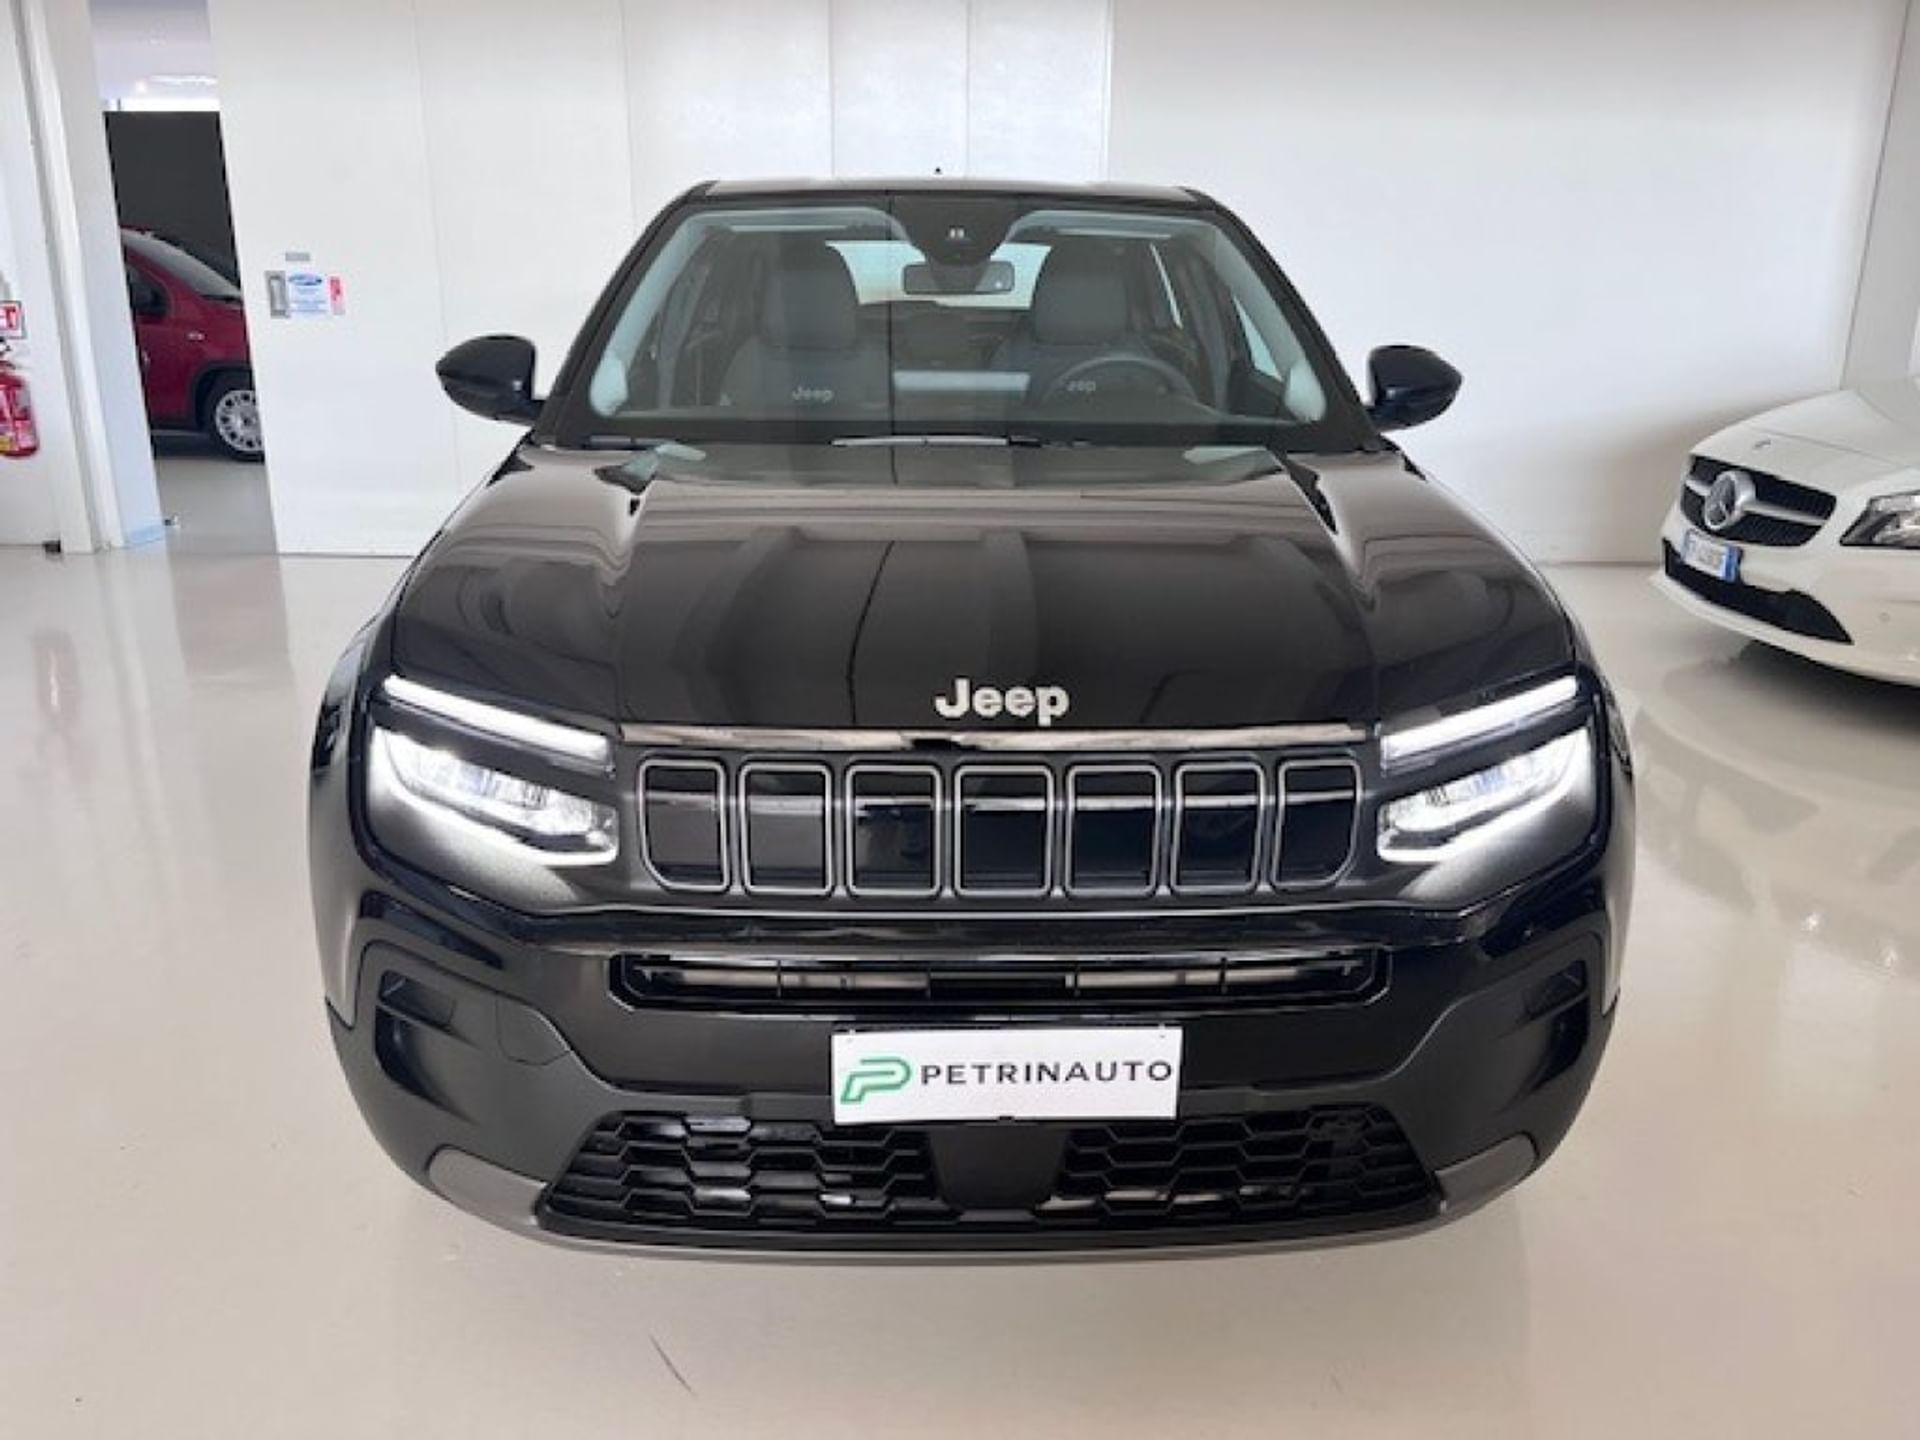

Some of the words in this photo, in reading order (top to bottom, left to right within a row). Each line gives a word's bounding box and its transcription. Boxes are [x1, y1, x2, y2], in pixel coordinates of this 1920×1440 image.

[791, 385, 834, 404] Jeep
[934, 677, 1070, 727] Jeep
[920, 1060, 1173, 1086] PETRINAUTO
